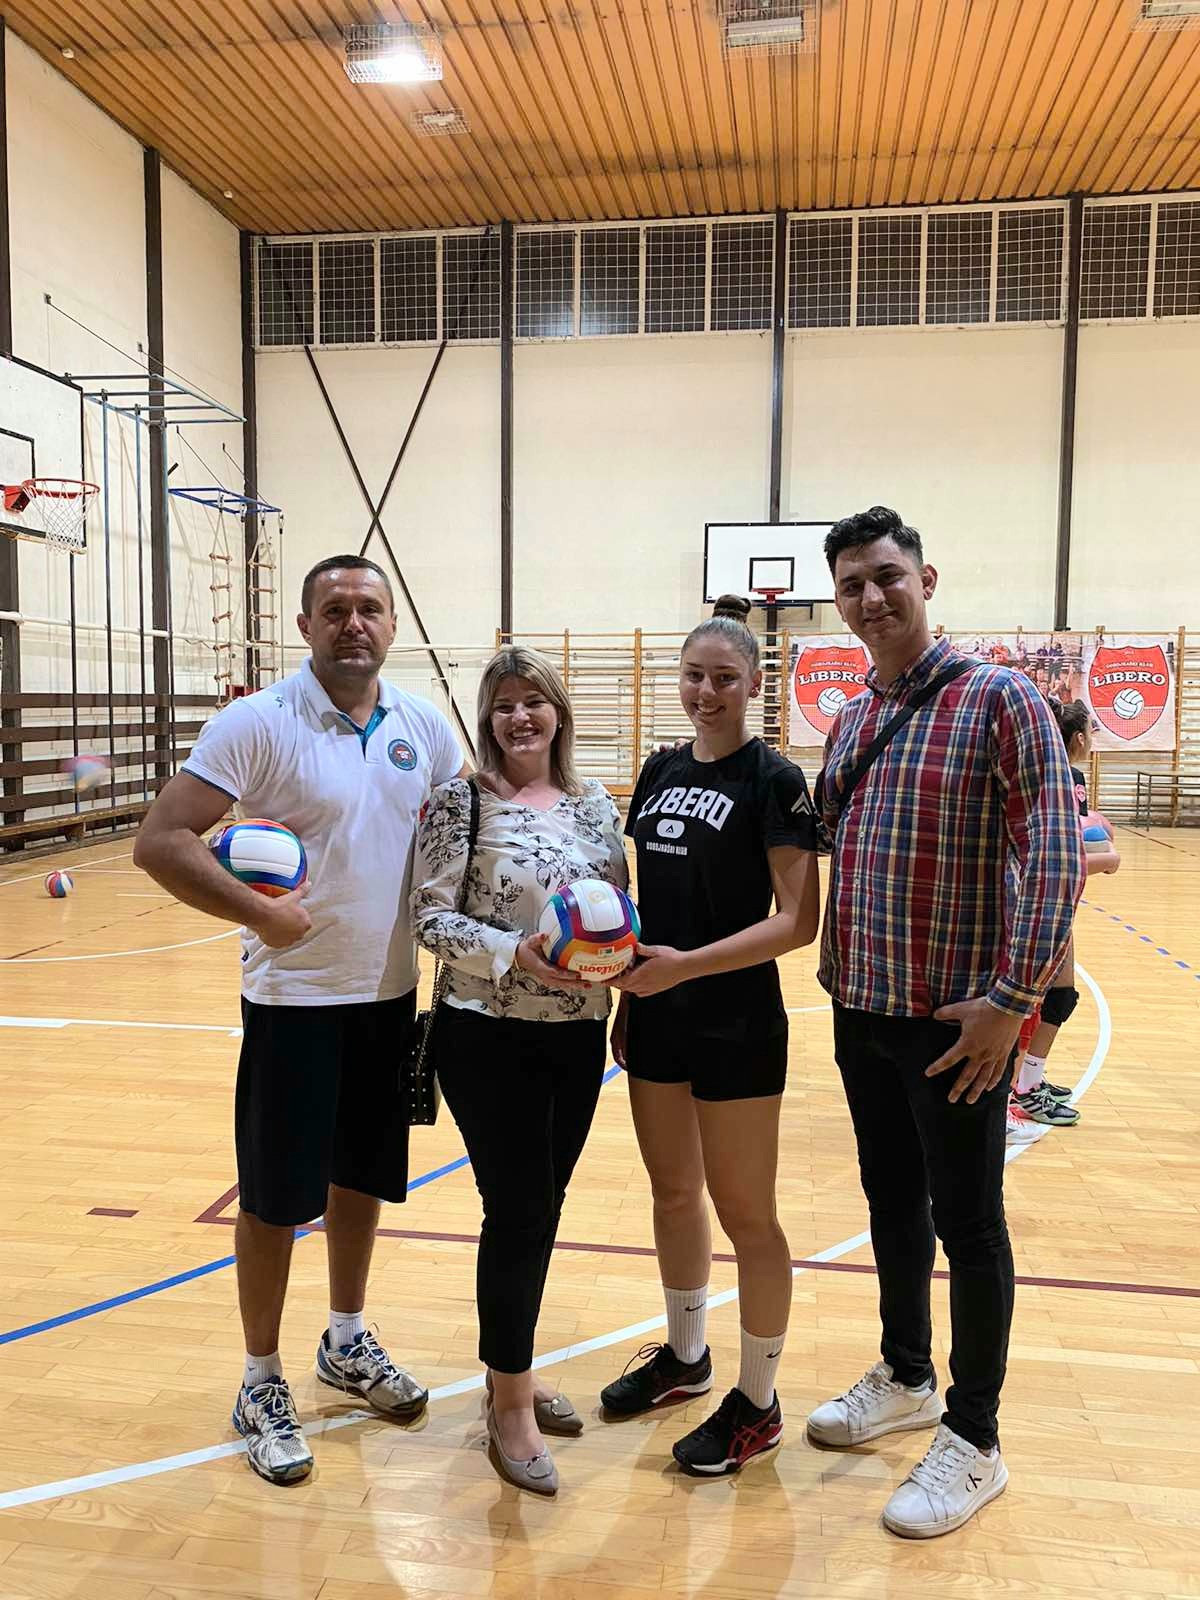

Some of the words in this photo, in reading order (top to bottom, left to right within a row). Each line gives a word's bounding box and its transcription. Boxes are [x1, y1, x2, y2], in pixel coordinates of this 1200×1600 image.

[798, 670, 866, 685] LIBERO
[1092, 671, 1166, 688] LIBERO
[637, 786, 735, 832] LIBERO
[578, 961, 625, 975] Wilson
